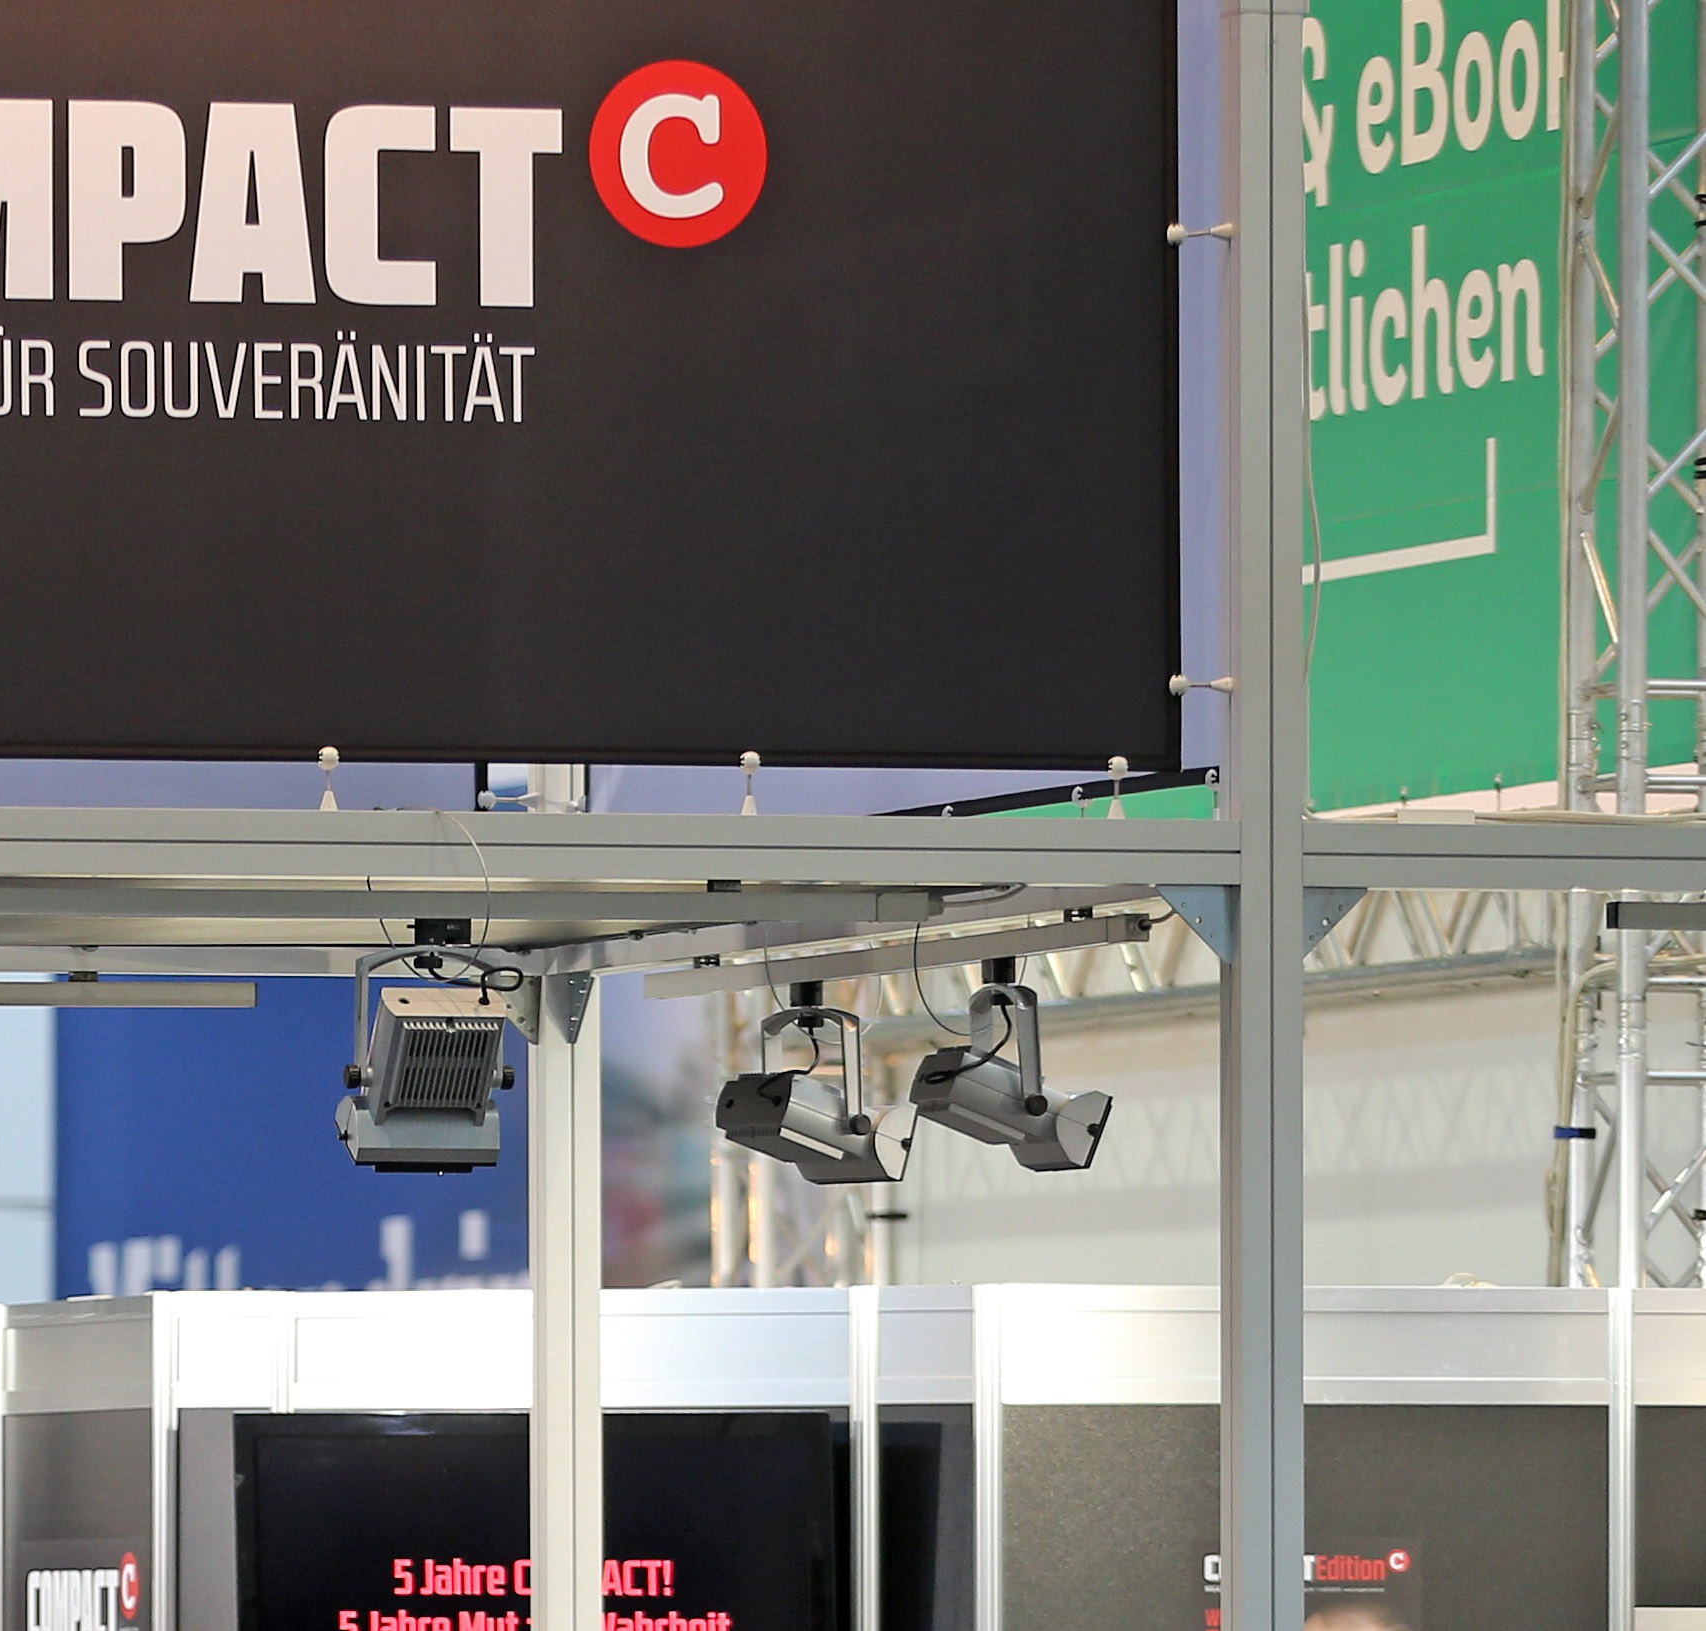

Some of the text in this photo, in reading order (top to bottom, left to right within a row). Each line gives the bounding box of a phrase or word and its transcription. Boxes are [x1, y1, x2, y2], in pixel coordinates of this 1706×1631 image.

[79, 331, 538, 424] SOUVERÄNITÄT
[393, 1559, 415, 1596] 5
[420, 1558, 507, 1596] Jahre
